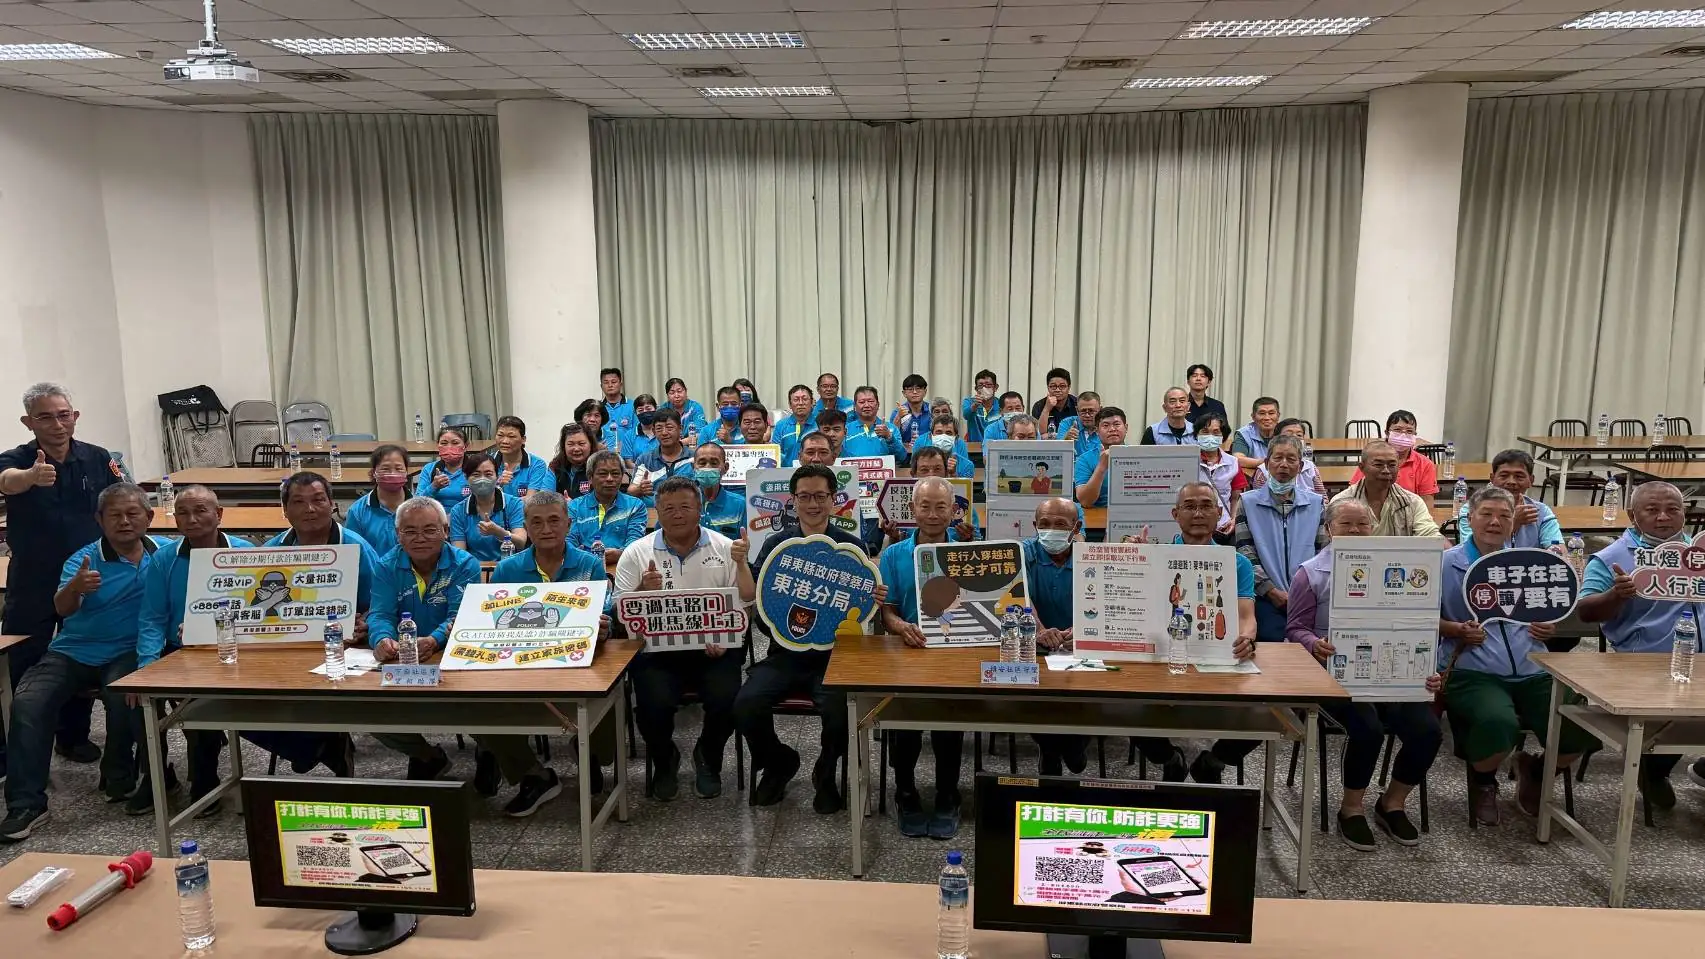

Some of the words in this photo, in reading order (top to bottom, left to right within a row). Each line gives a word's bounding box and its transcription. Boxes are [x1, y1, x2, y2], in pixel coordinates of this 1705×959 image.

[946, 549, 1014, 562] 走行人穿越道
[1636, 550, 1705, 568] 紅燈停
[780, 554, 874, 594] 屏東縣政府警察局
[948, 562, 1016, 577] 安全才可靠
[1488, 565, 1568, 584] 車子在走
[212, 577, 252, 588] 升級VIP
[294, 574, 337, 585] 大量扣款
[772, 572, 850, 612] 東港分局
[193, 600, 242, 610] +886話
[484, 598, 522, 610] 加LINE
[545, 594, 588, 607] 陌生來電
